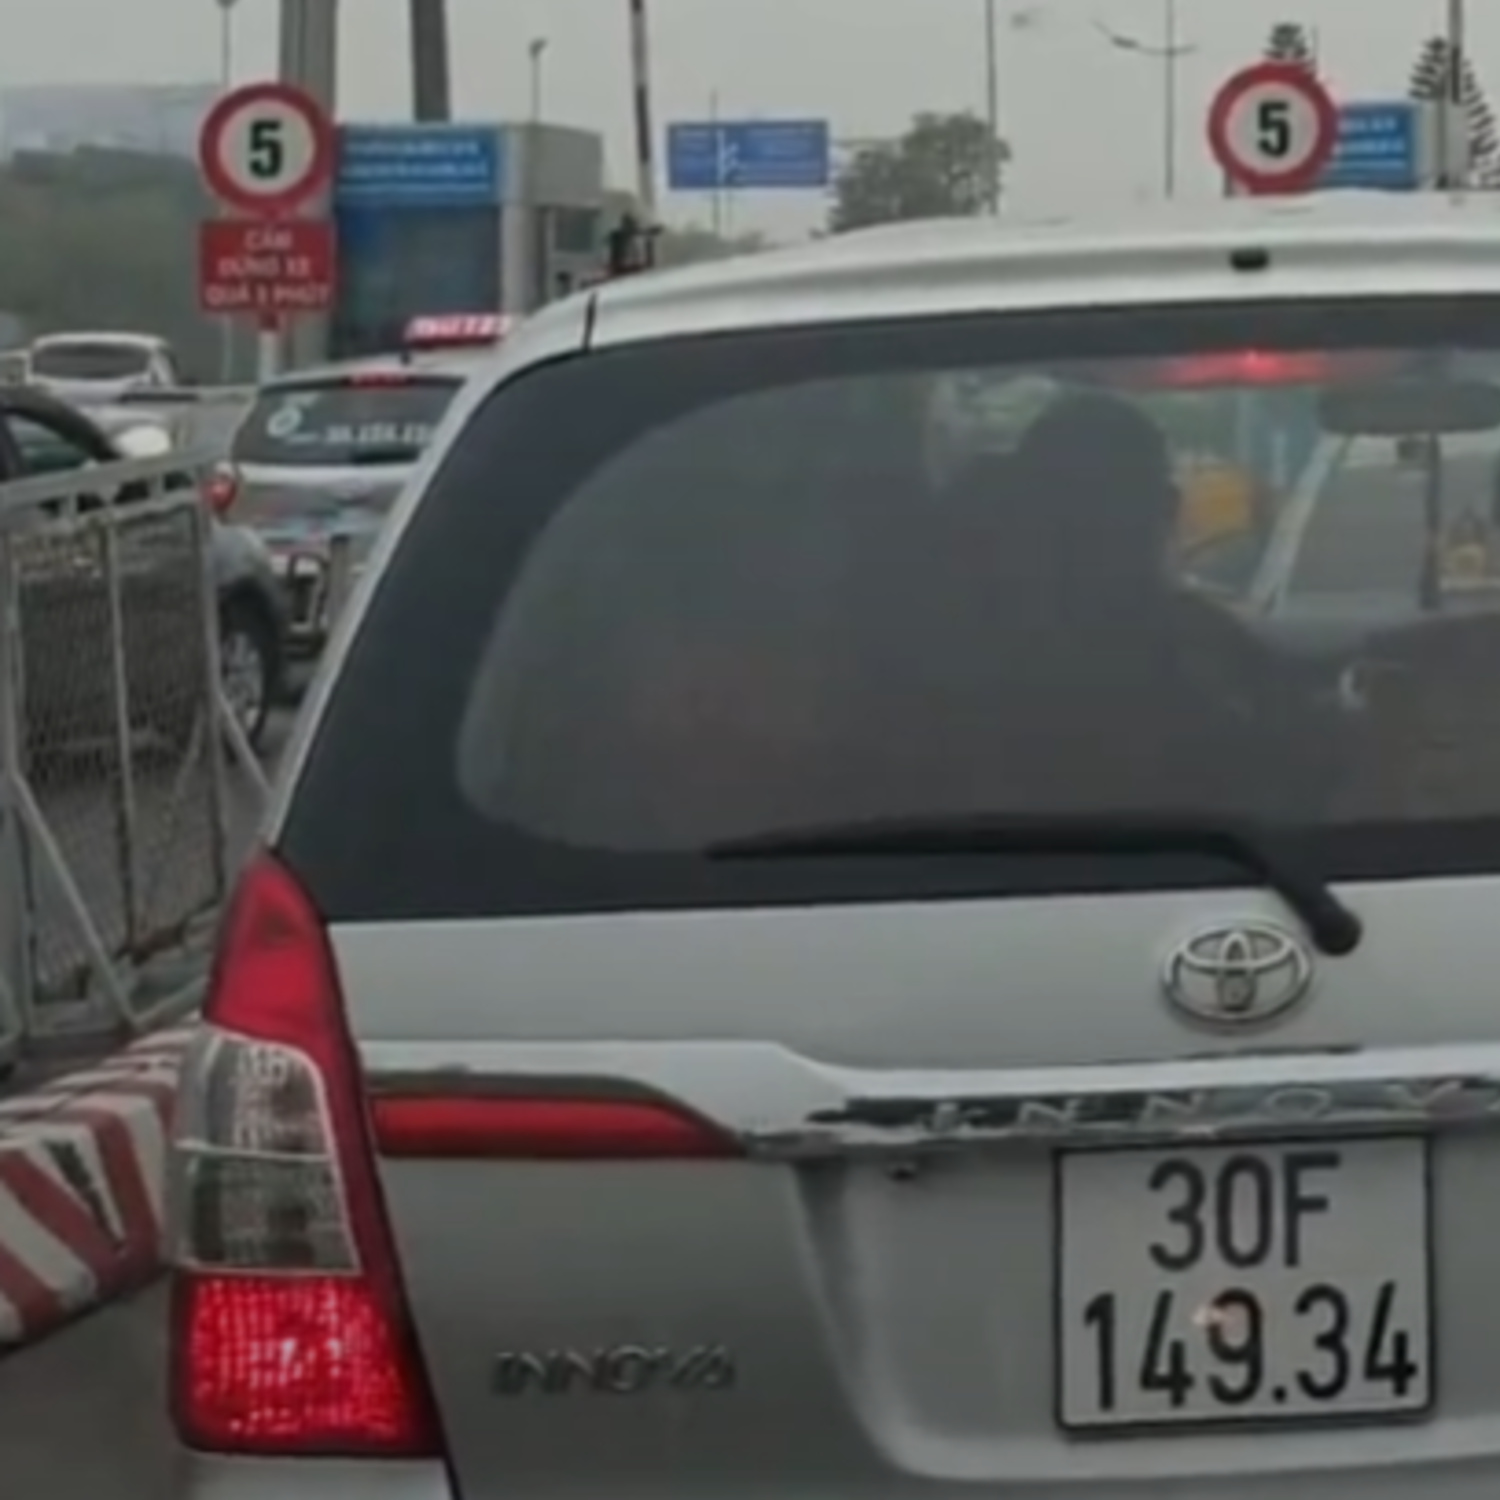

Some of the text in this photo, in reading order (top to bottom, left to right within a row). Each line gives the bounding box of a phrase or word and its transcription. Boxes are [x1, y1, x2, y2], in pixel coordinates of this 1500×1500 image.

[250, 119, 283, 180] 5
[1258, 100, 1290, 158] 5
[1148, 1152, 1341, 1270] 30F
[1083, 1282, 1417, 1411] 149.34
